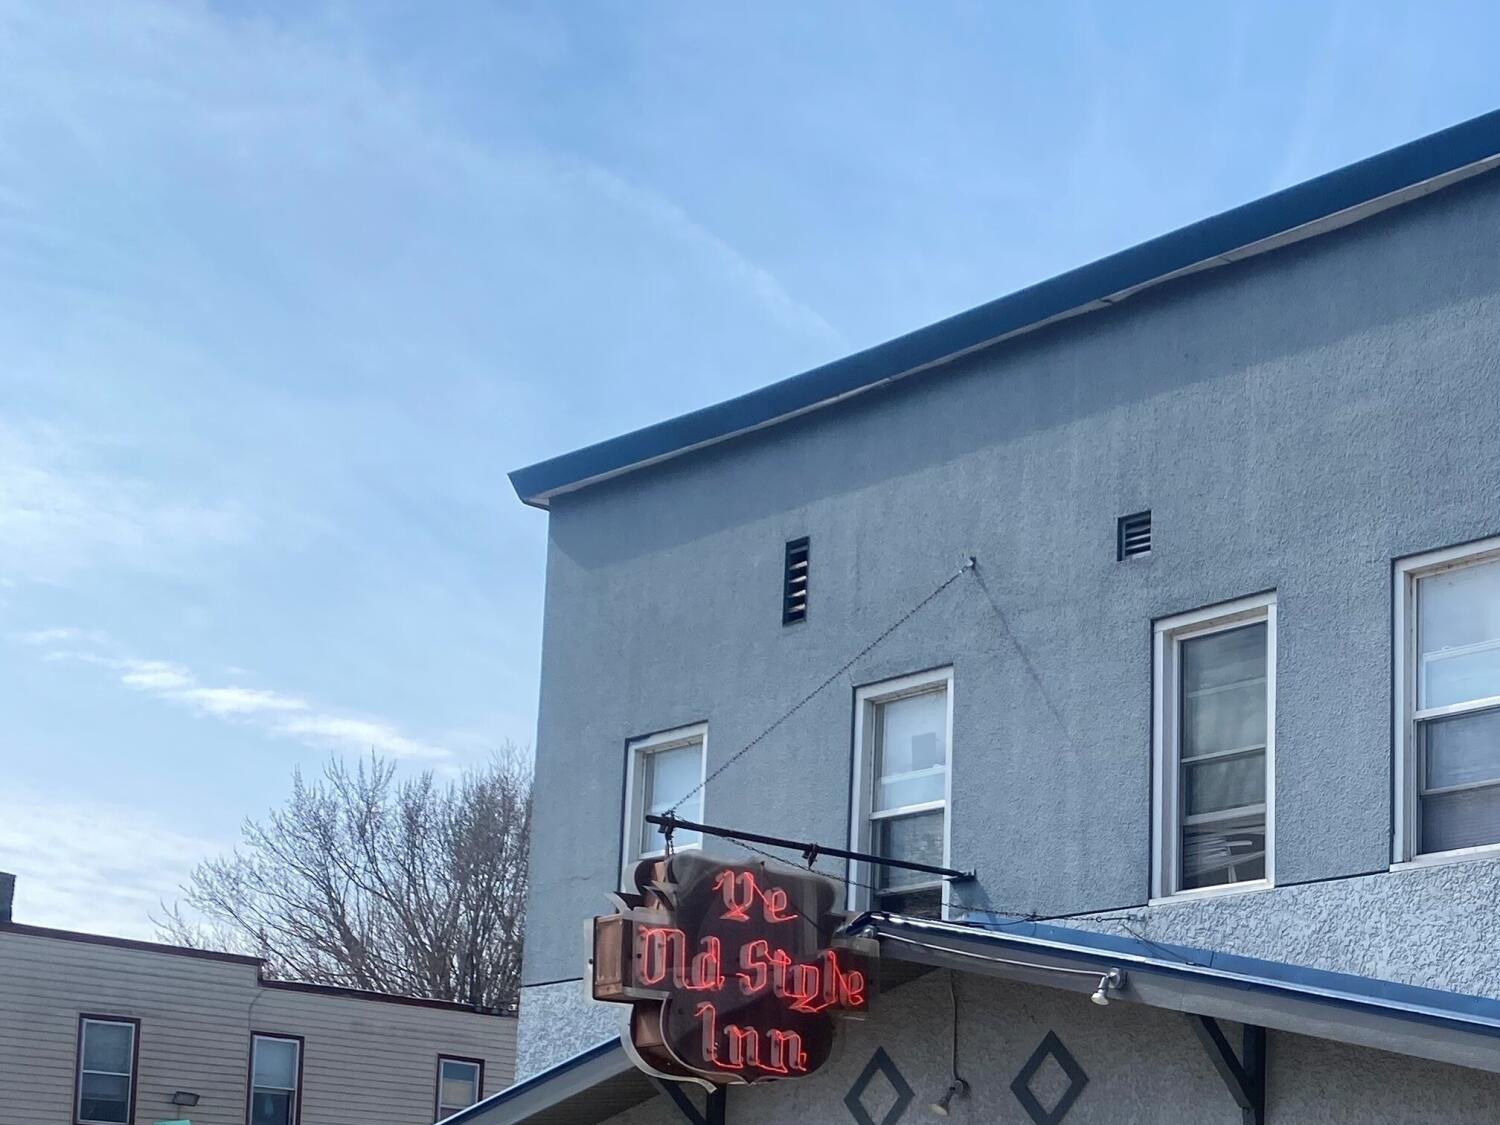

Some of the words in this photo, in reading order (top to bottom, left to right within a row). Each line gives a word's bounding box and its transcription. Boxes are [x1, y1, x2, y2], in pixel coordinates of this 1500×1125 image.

[712, 869, 798, 923] Ye
[638, 924, 726, 991] Old
[734, 939, 865, 1013] Style
[693, 1001, 807, 1073] Inn
